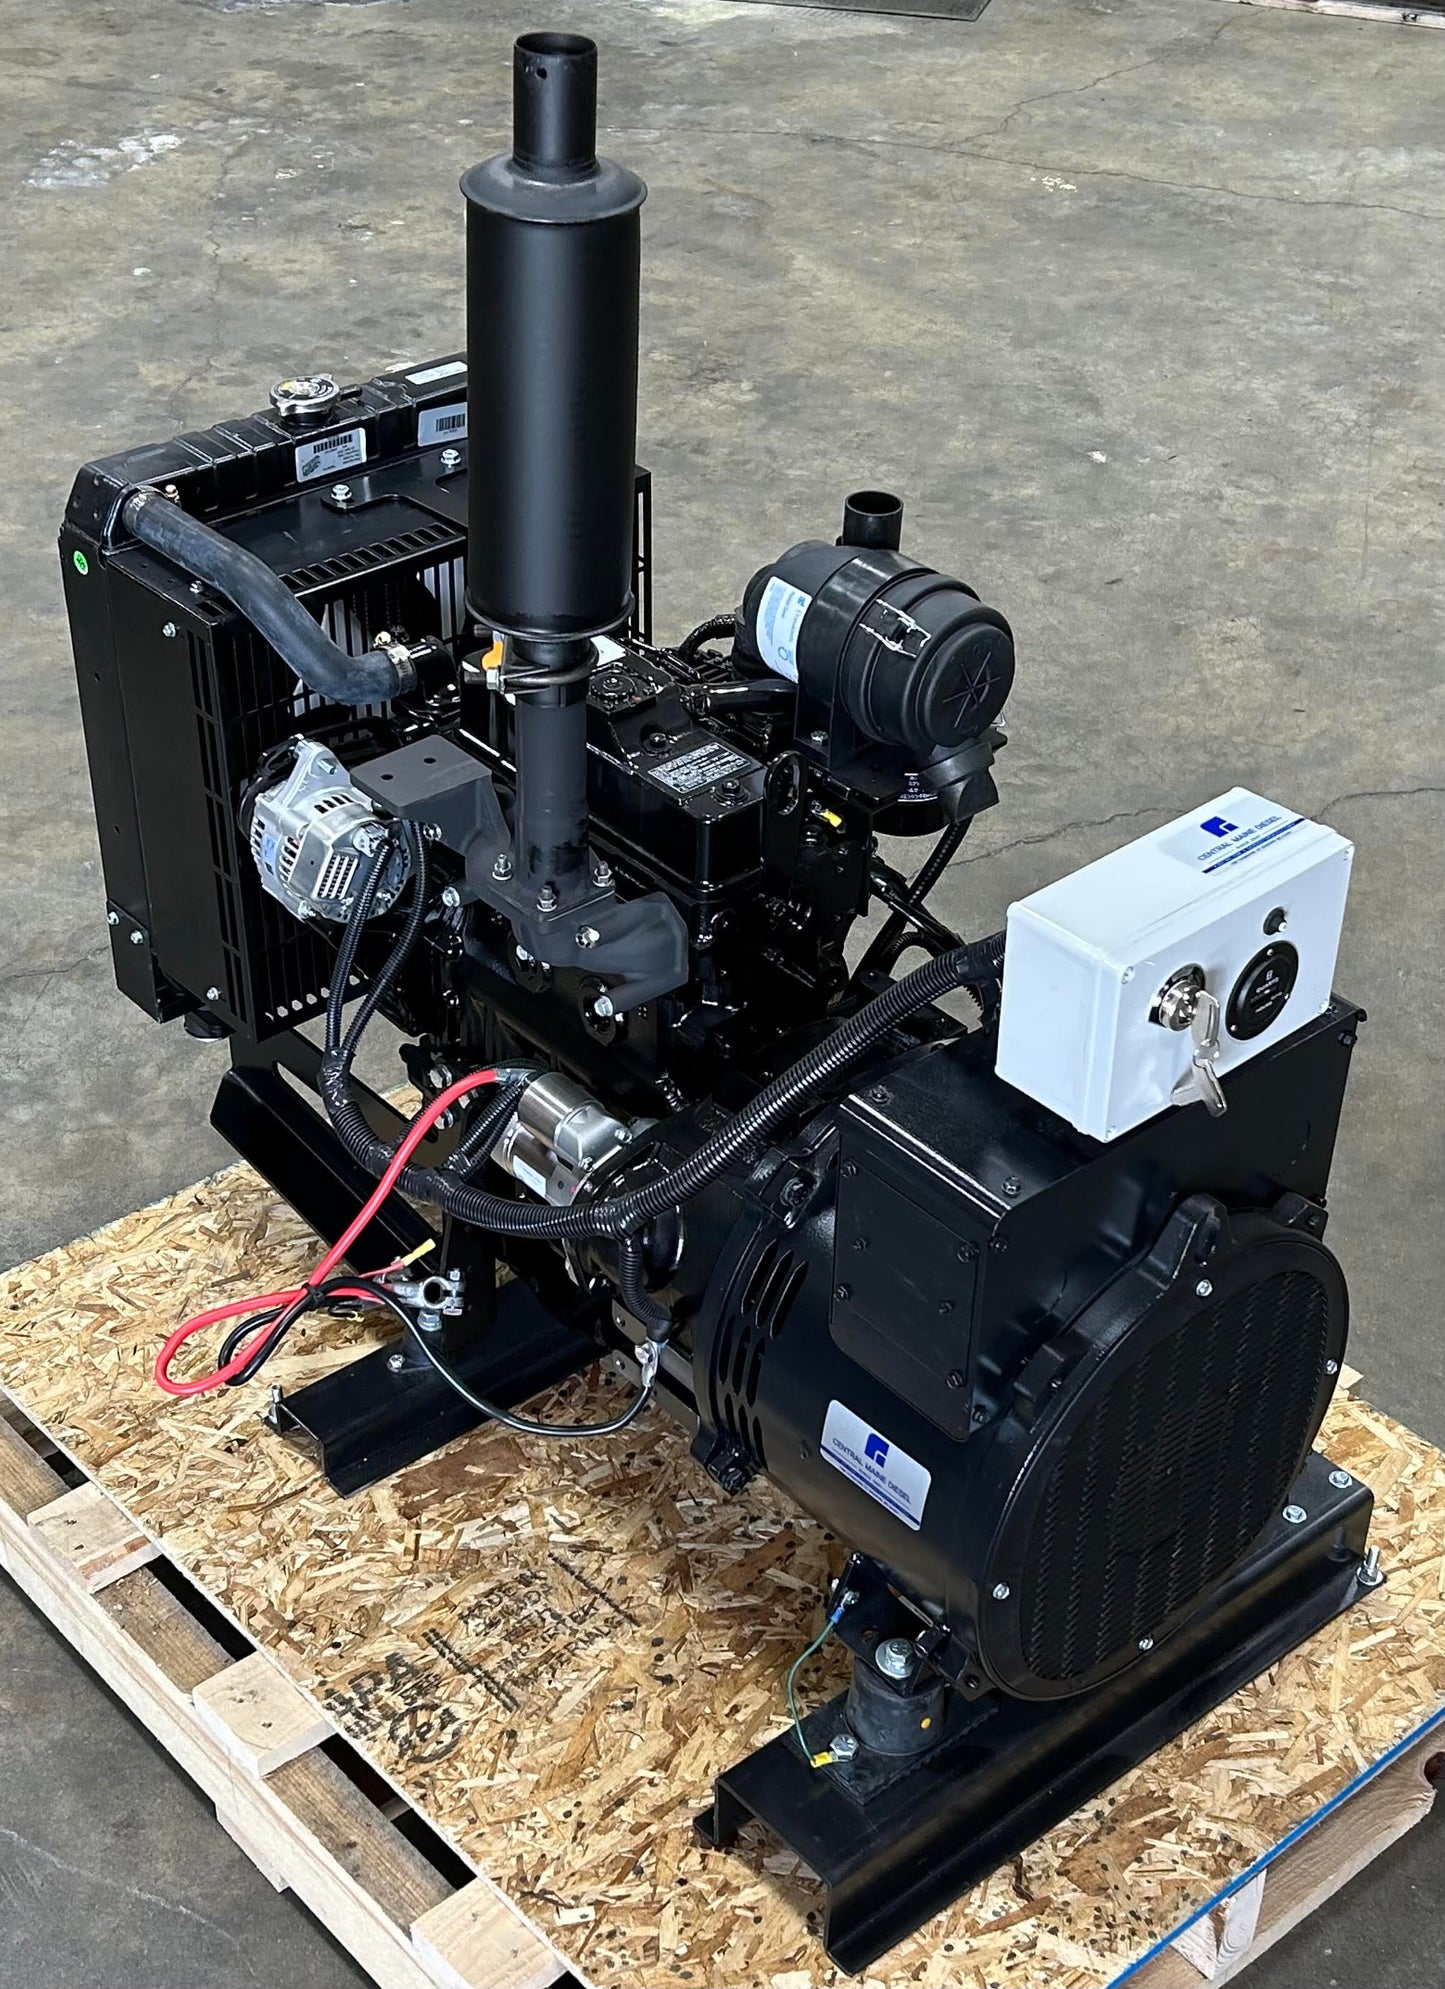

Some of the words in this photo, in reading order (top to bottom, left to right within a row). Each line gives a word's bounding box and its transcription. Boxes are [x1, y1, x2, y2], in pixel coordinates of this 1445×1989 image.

[1197, 842, 1233, 861] CENTRAL
[1231, 828, 1255, 843] MAINE
[1254, 816, 1283, 830] DIESEL
[832, 1437, 863, 1465] CENTRAL
[864, 1462, 888, 1484] MAINE
[887, 1480, 912, 1504] DIESEL
